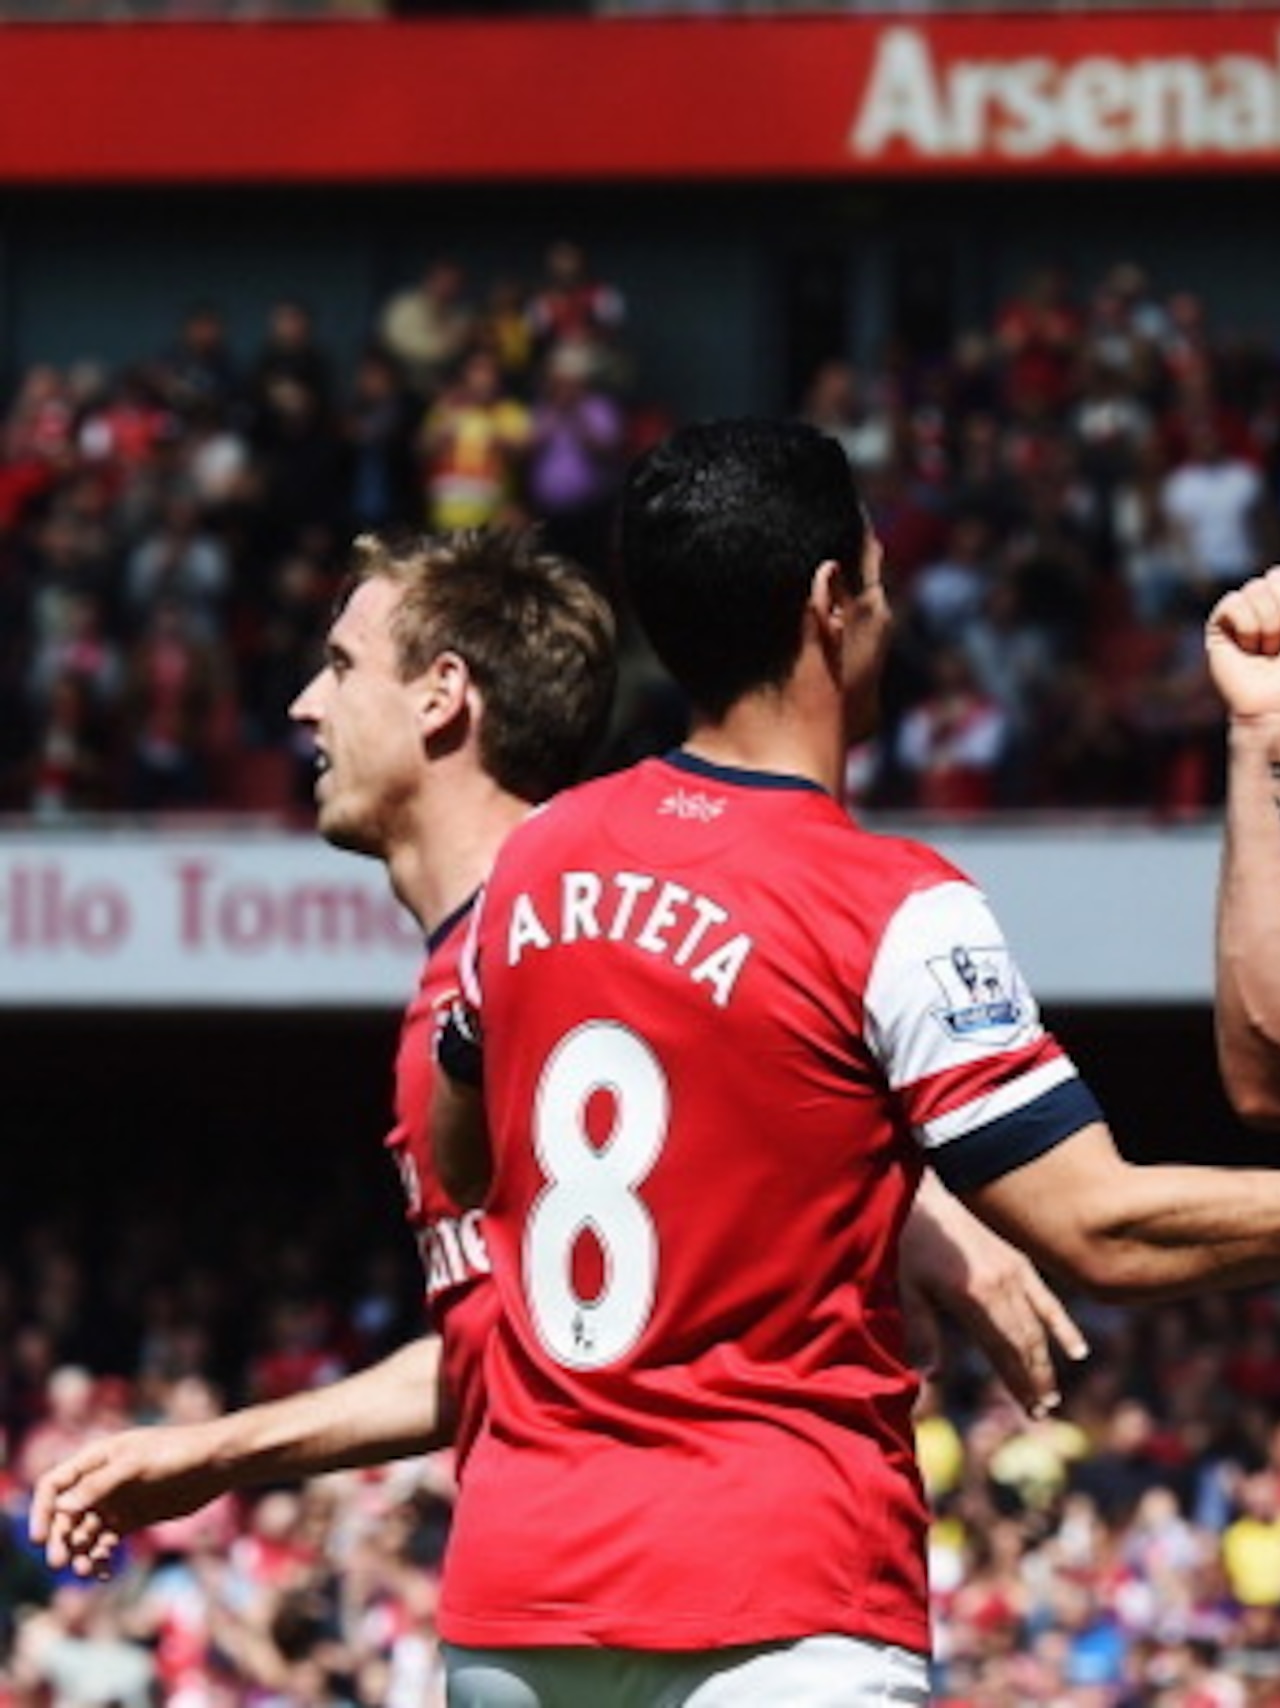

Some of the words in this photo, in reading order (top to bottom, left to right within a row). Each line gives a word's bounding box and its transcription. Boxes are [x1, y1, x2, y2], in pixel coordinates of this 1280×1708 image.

[0, 863, 131, 957] llo
[507, 871, 752, 1008] ARTETA
[521, 1018, 671, 1371] 8
